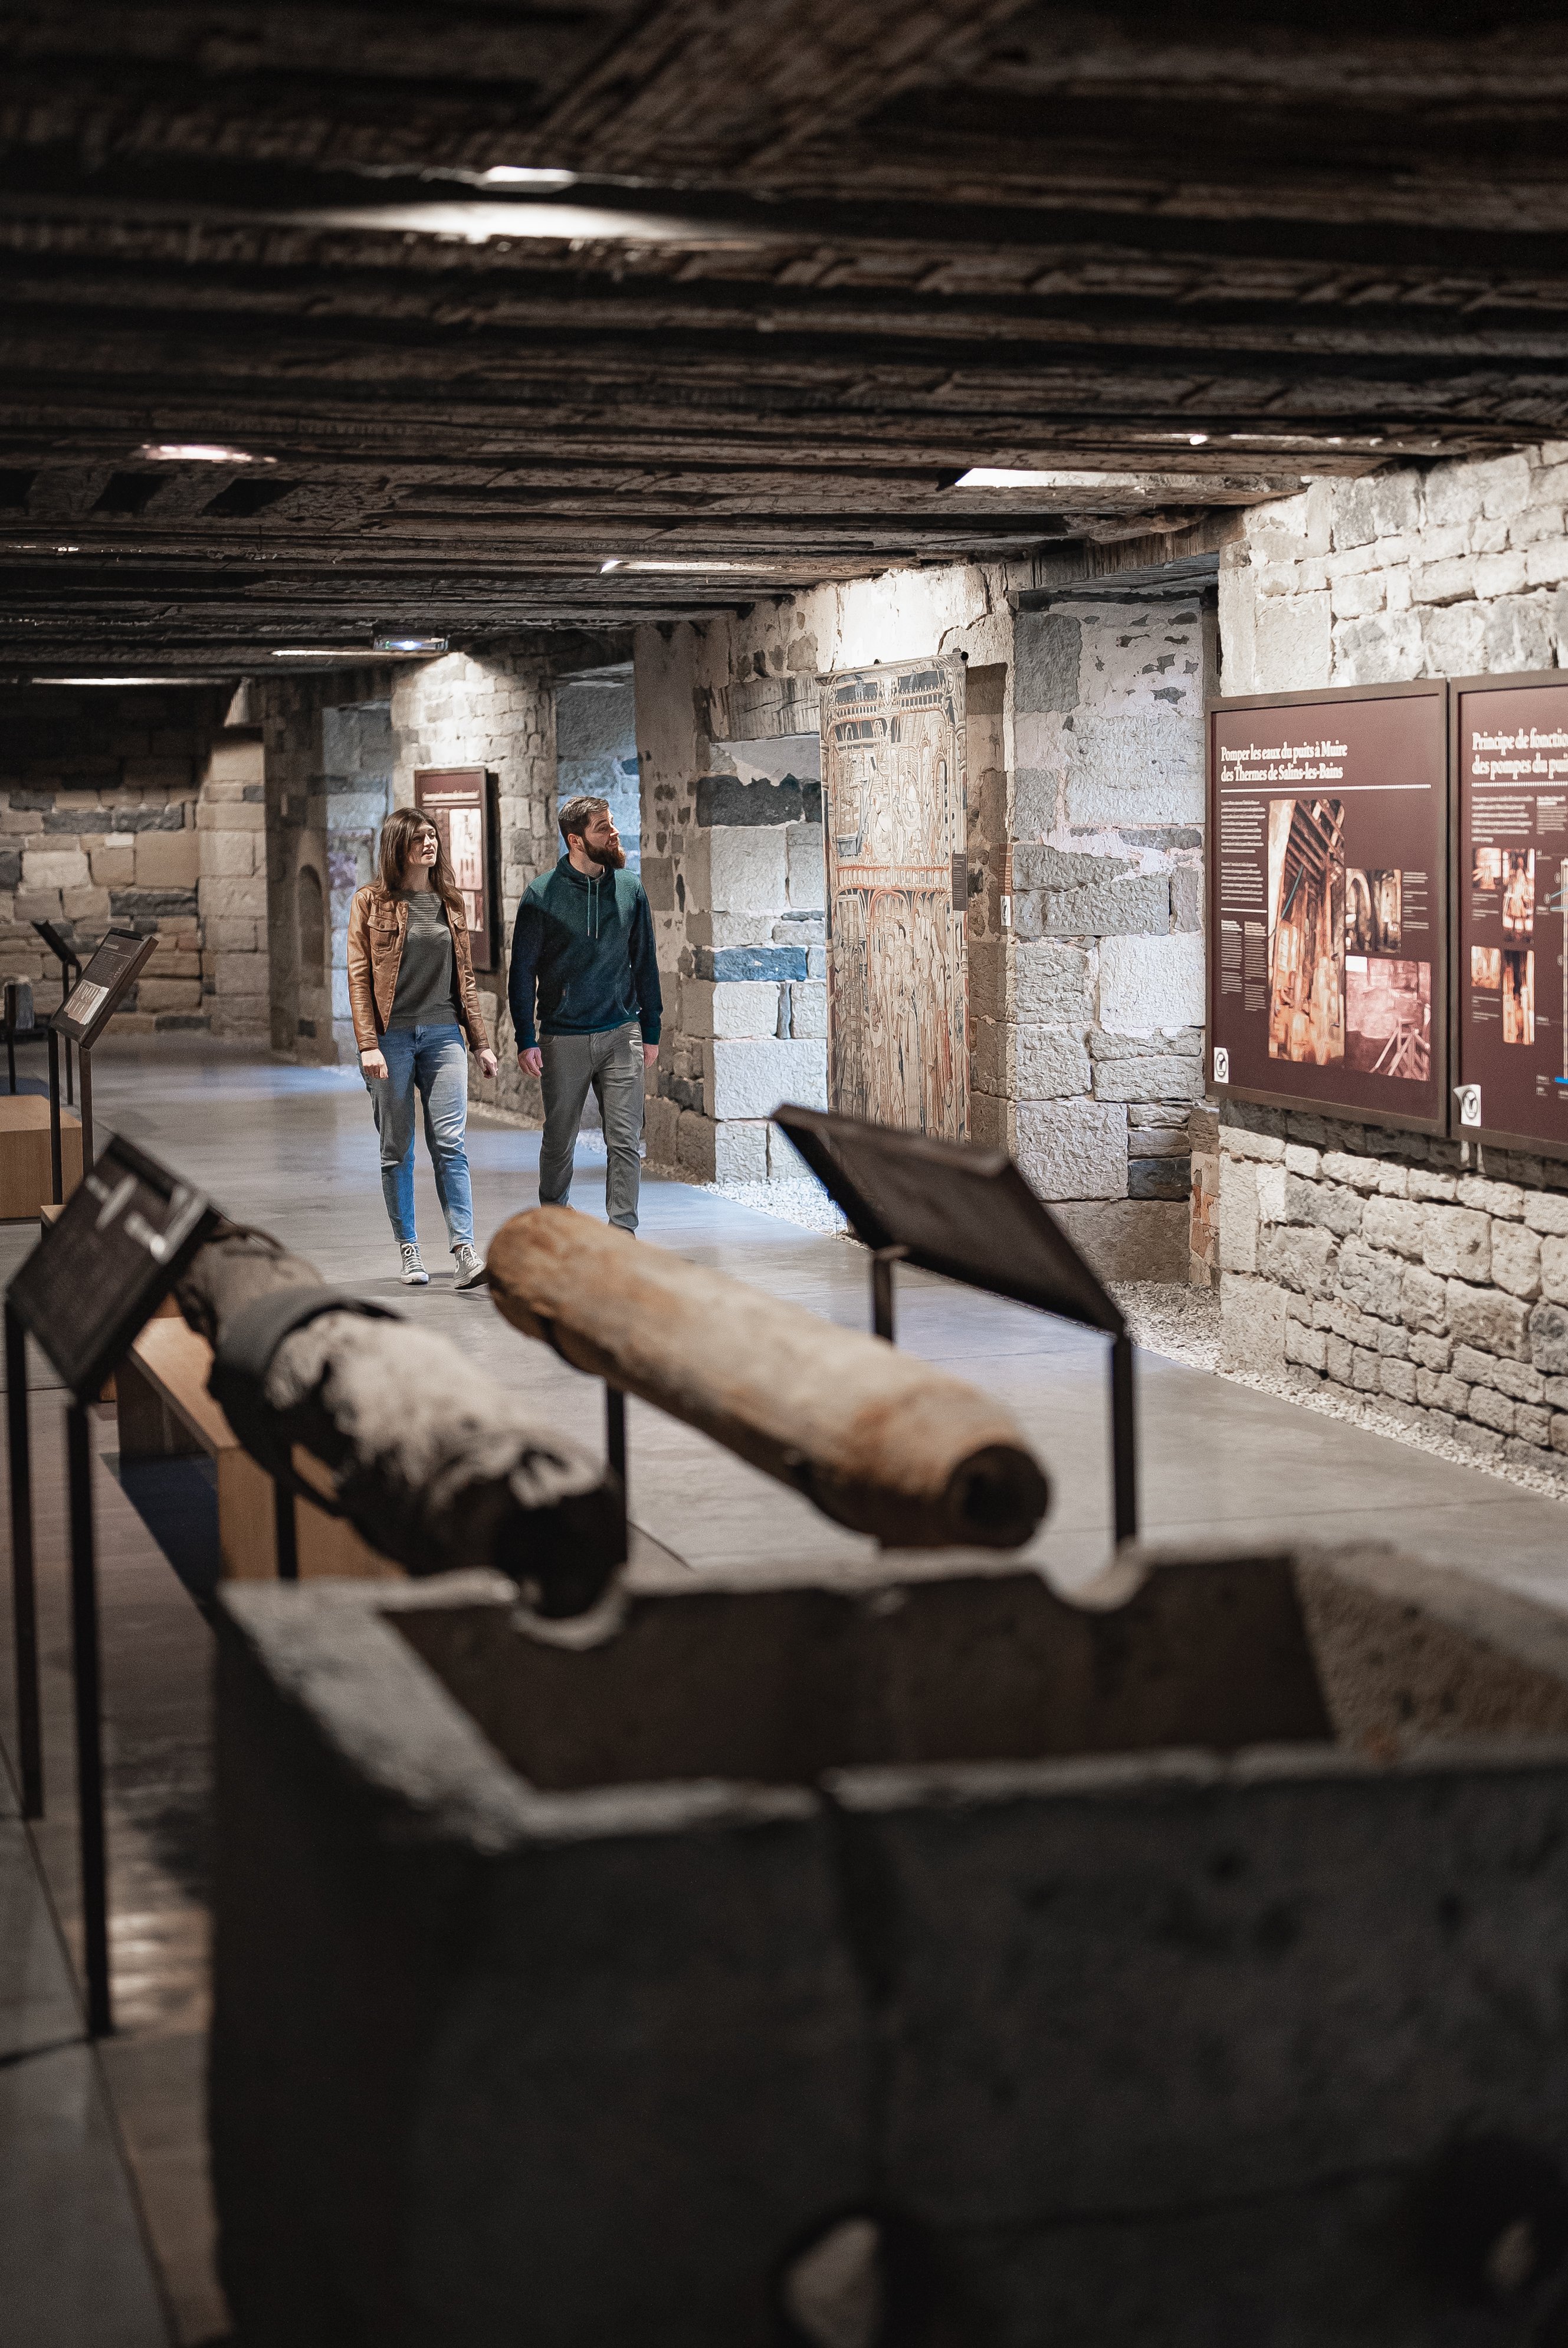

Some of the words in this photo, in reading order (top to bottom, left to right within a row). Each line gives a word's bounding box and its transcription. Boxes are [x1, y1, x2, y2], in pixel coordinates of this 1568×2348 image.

[1221, 746, 1249, 766] Pomper
[1250, 743, 1261, 760] les
[1261, 747, 1281, 760] eaux
[1281, 741, 1293, 759] du
[1293, 742, 1314, 764] puits
[1314, 741, 1320, 757] à
[1321, 740, 1348, 757] Muire
[1472, 730, 1515, 756] Principe
[1515, 727, 1530, 749] de
[1221, 765, 1234, 782] des
[1234, 765, 1267, 781] Thermes
[1268, 763, 1278, 781] de
[1278, 762, 1343, 781] Salins-les-Bains
[1471, 754, 1490, 775] des
[1490, 759, 1531, 781] pompes
[1532, 752, 1548, 773] du
